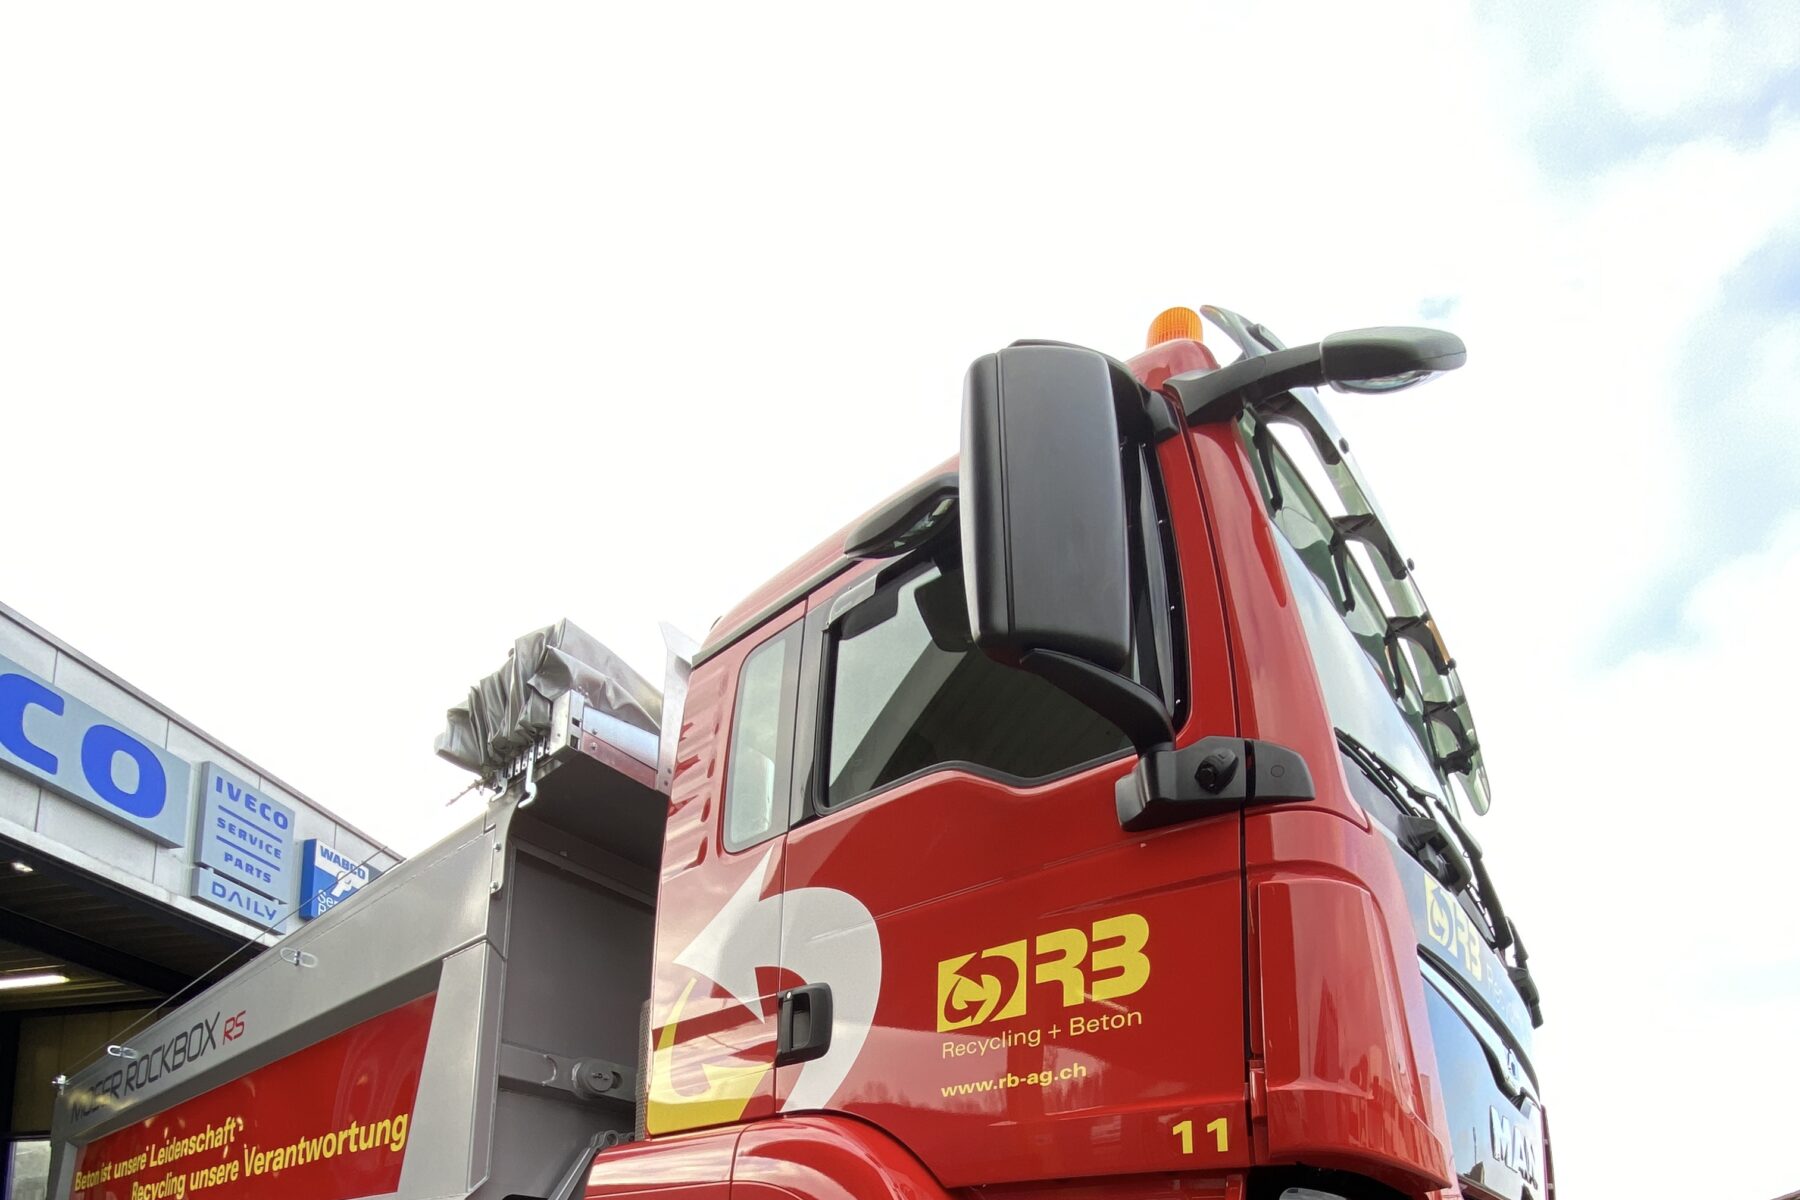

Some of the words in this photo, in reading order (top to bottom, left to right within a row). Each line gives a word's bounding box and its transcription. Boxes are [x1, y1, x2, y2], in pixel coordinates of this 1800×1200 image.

[0, 673, 167, 819] CO
[215, 776, 289, 830] IVECO
[217, 817, 282, 859] SERVICE
[320, 845, 366, 880] WABCO
[224, 852, 272, 883] PARTS
[211, 881, 277, 920] DAILY
[1035, 913, 1151, 1008] RB
[1455, 902, 1482, 982] RB
[124, 1011, 221, 1096] ROCKBOX
[222, 1010, 246, 1046] RS
[942, 1027, 1042, 1060] Recycling
[1047, 1023, 1062, 1040] +
[1069, 1009, 1142, 1037] Beton
[940, 1063, 1088, 1098] www.rb-ag.ch
[74, 1169, 100, 1191] Beton
[100, 1161, 112, 1182] ist
[113, 1154, 147, 1180] unsere
[149, 1116, 237, 1168] Leidenschaft
[189, 1158, 240, 1192] unsere
[244, 1113, 408, 1177] Verantwortung
[1172, 1117, 1229, 1155] 11
